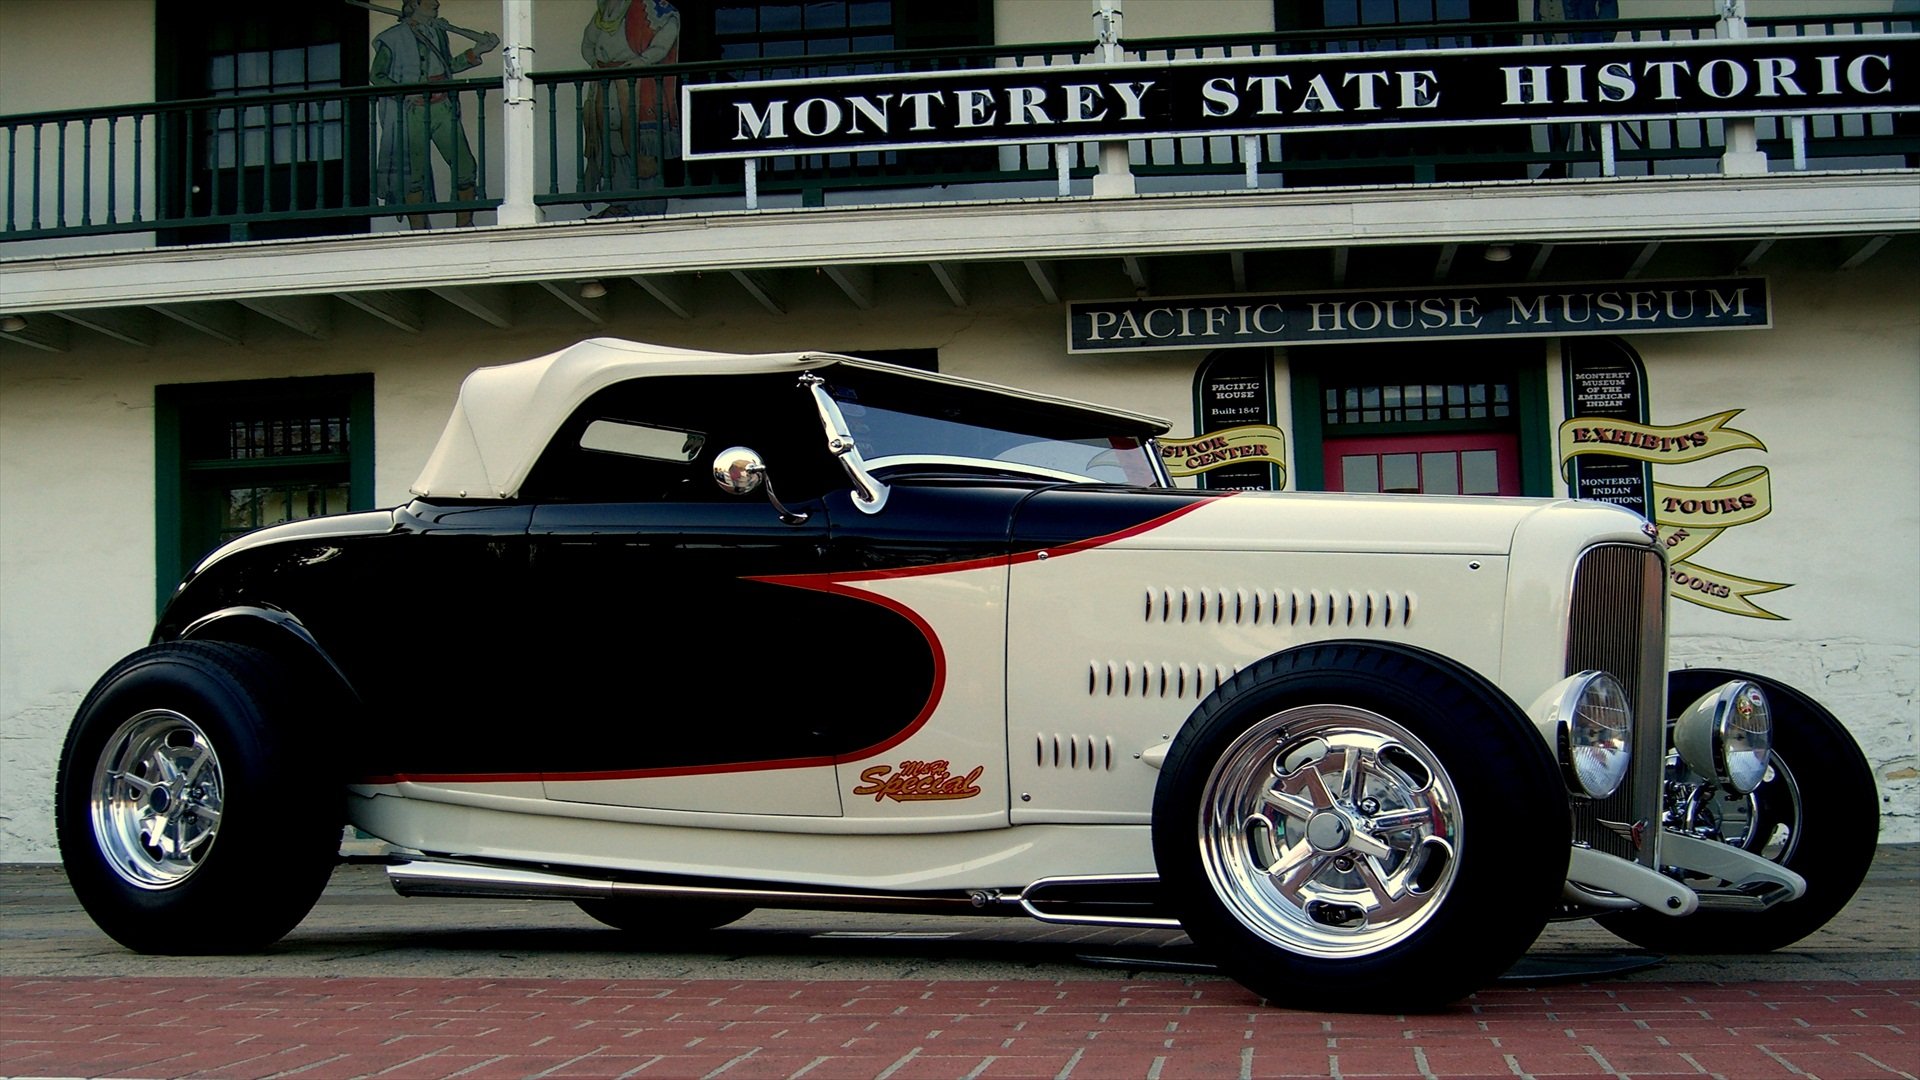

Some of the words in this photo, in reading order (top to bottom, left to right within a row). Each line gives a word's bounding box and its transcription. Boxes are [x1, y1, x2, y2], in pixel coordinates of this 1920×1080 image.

[731, 80, 1156, 142] MONTEREY
[1201, 70, 1440, 118] STATE
[1499, 53, 1893, 106] HISTORIC
[1086, 303, 1286, 341] PACIFIC
[1307, 296, 1483, 332] HOUSE
[1507, 288, 1752, 325] MUSEUM
[1575, 372, 1631, 380] MONTEREY
[1211, 382, 1260, 391] PACIFIC
[1582, 379, 1626, 387] MUSEUM
[1216, 391, 1255, 400] HOUSE
[1577, 393, 1631, 401] AMERICAN
[1586, 400, 1623, 408] INDIAN
[1211, 407, 1236, 415] Built
[1238, 406, 1260, 414] 1847
[1573, 427, 1709, 453] EXHIBITS
[1158, 436, 1229, 458] SITOR
[1185, 443, 1270, 469] CENTER
[1592, 486, 1631, 495] INDIAN
[1582, 496, 1643, 504] DITIONS
[1662, 493, 1757, 515] TOURS
[853, 765, 984, 803] Special
